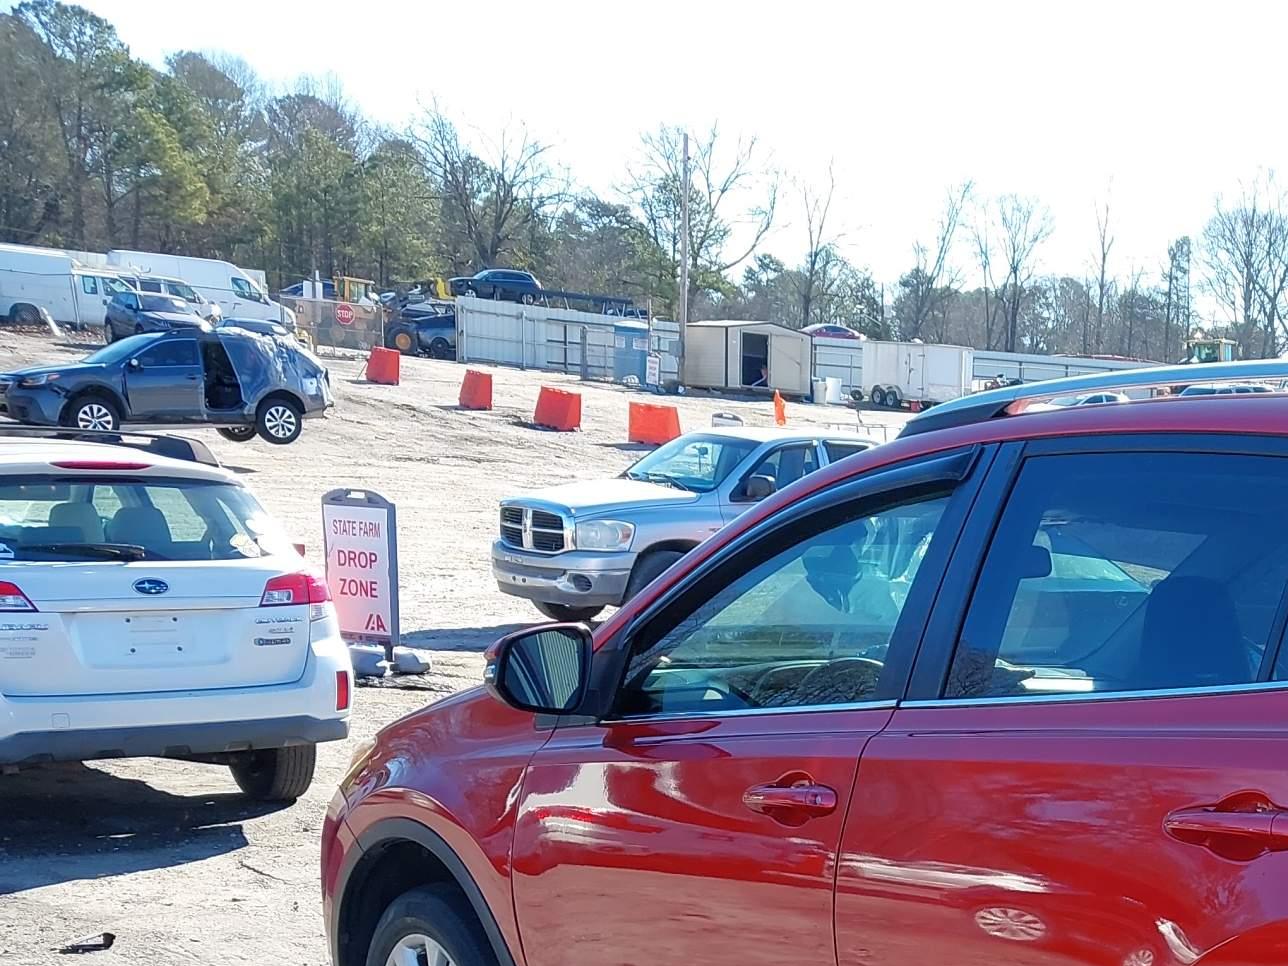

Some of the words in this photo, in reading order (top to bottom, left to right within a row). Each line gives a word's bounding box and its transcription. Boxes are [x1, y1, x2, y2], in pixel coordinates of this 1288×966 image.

[336, 309, 353, 319] STOP
[332, 519, 357, 537] STATE
[358, 520, 381, 539] FARM
[337, 549, 378, 569] DROP
[339, 578, 378, 598] ZONE
